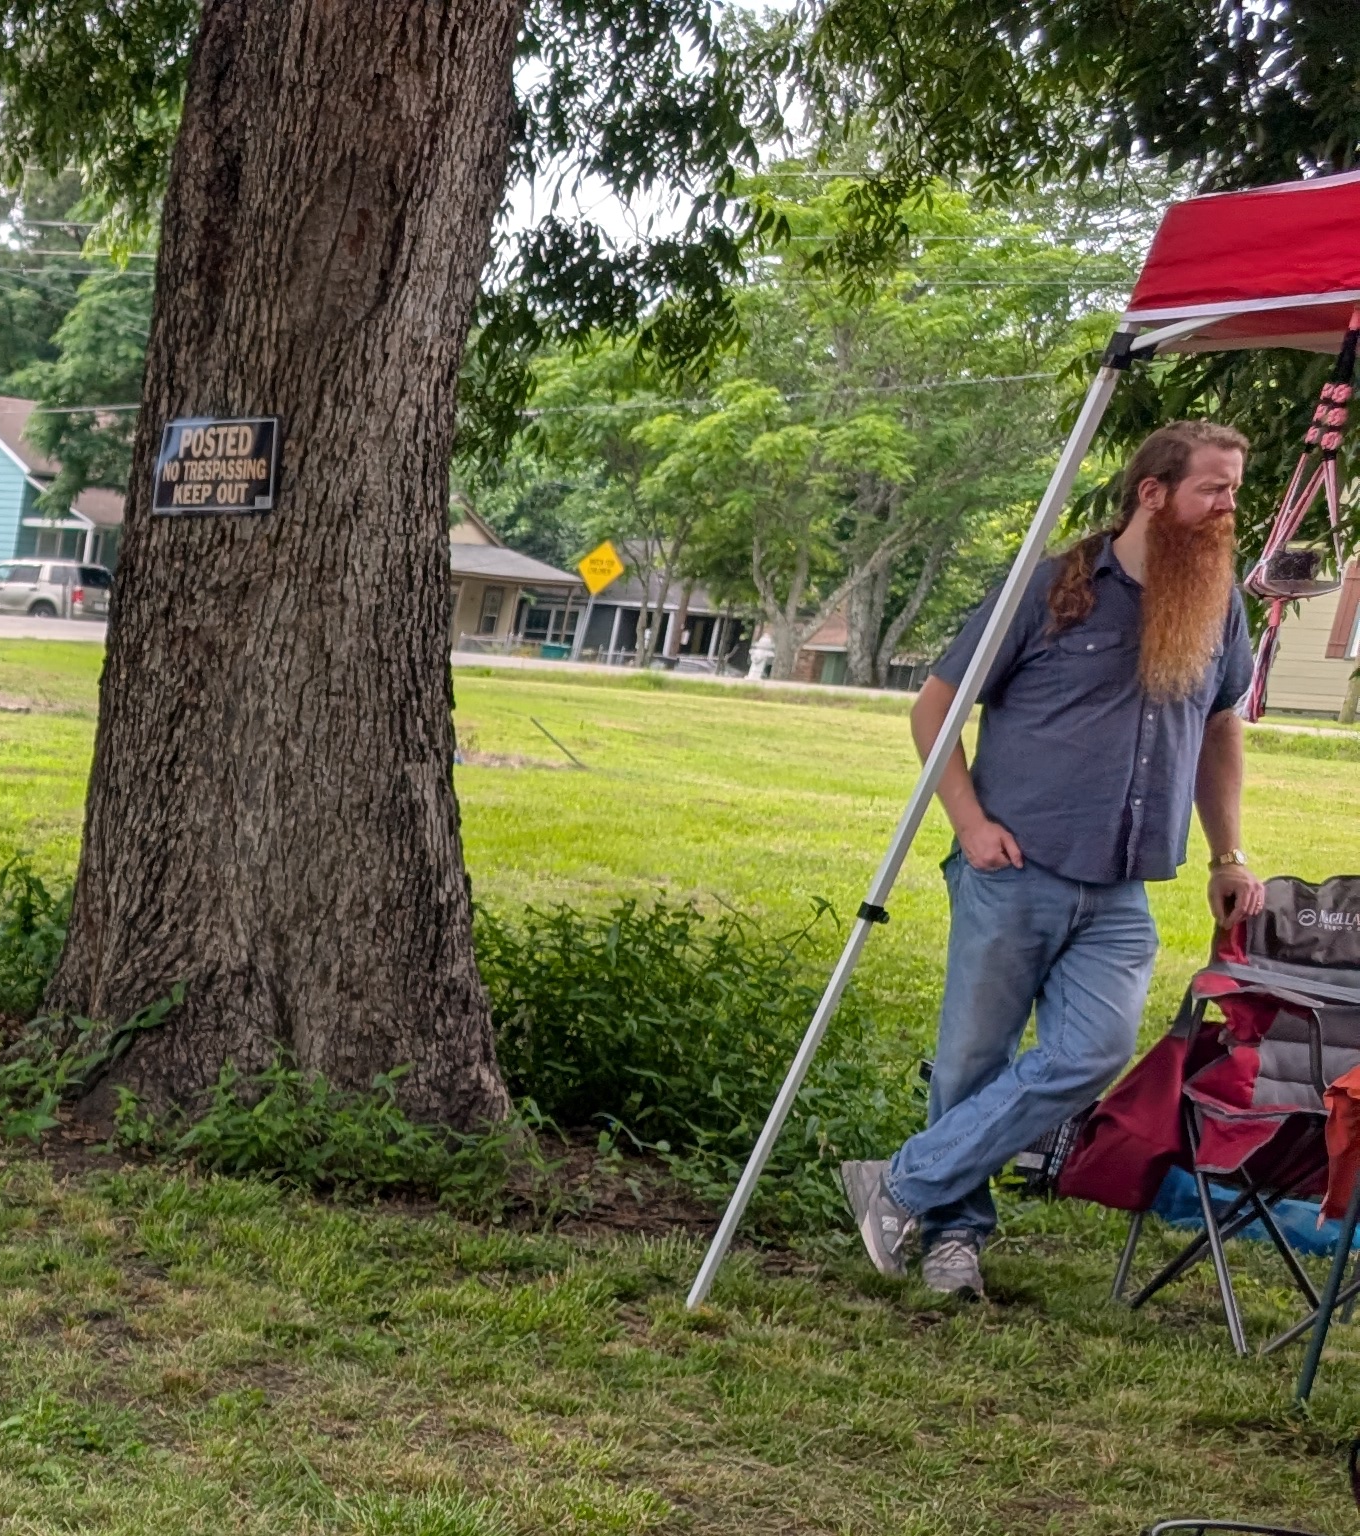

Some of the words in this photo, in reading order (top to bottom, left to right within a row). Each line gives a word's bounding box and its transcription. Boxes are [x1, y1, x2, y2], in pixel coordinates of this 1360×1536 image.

[179, 426, 253, 459] POSTED
[162, 462, 180, 482] NO
[183, 458, 268, 481] TRESPASSING
[172, 484, 213, 505] KEEP
[216, 482, 250, 504] OUT
